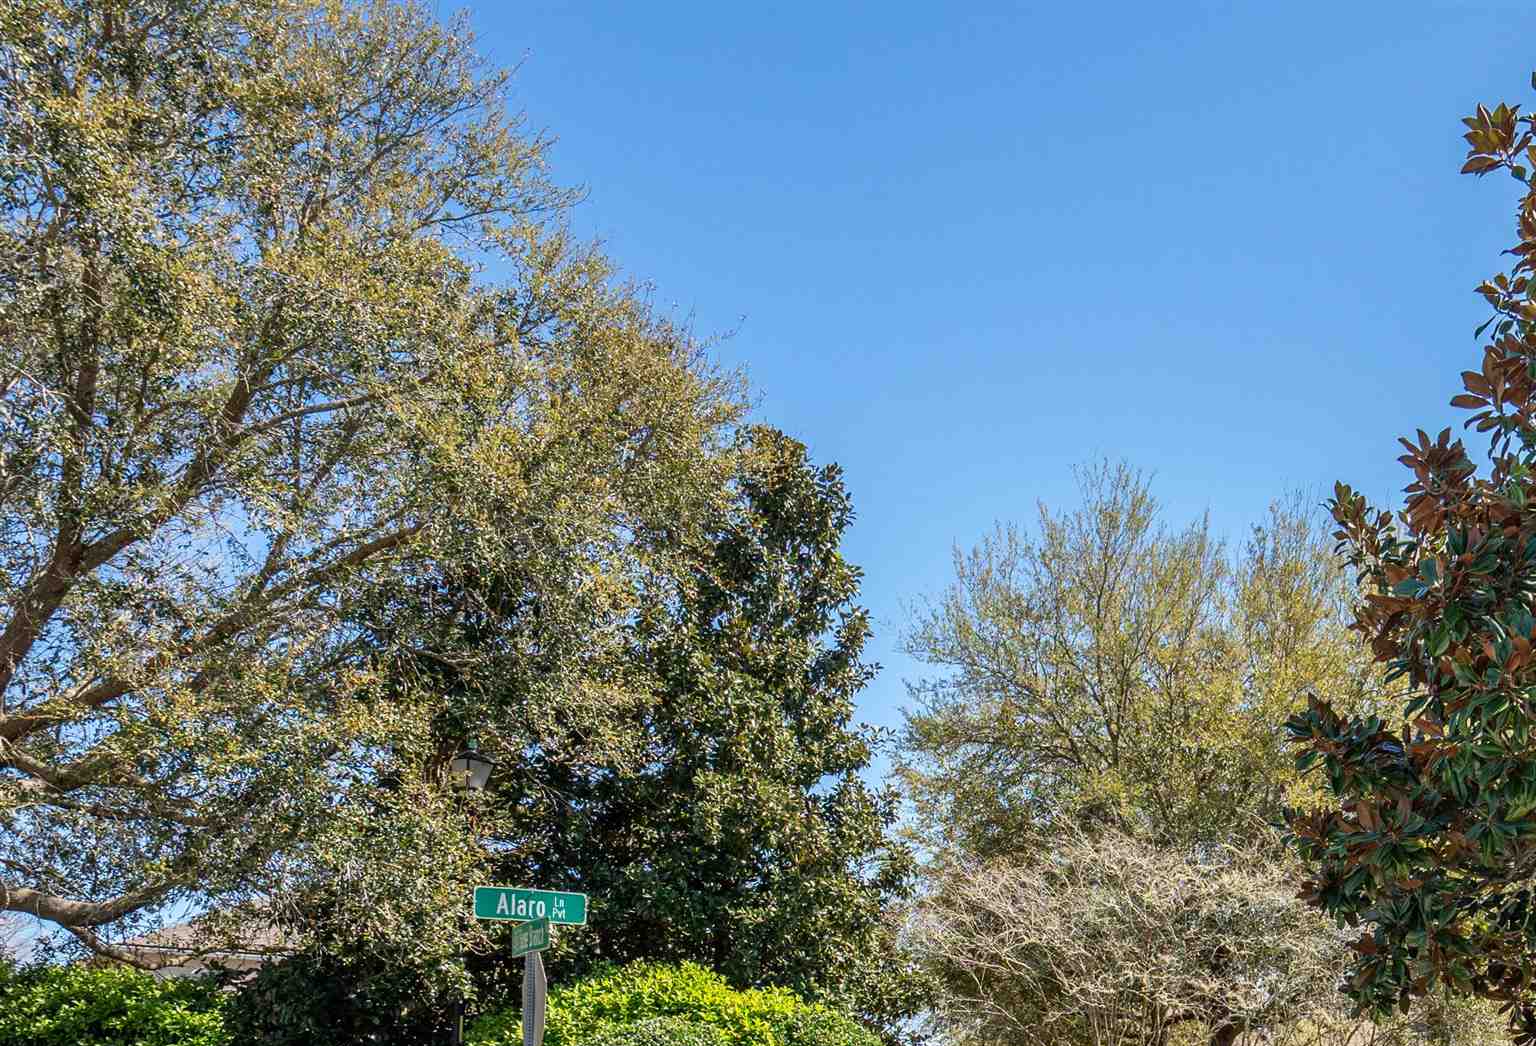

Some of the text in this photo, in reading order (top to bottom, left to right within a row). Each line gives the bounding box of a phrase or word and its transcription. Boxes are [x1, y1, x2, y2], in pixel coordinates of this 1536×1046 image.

[496, 892, 565, 918] Alaro Ln
[552, 908, 566, 919] Pvt
